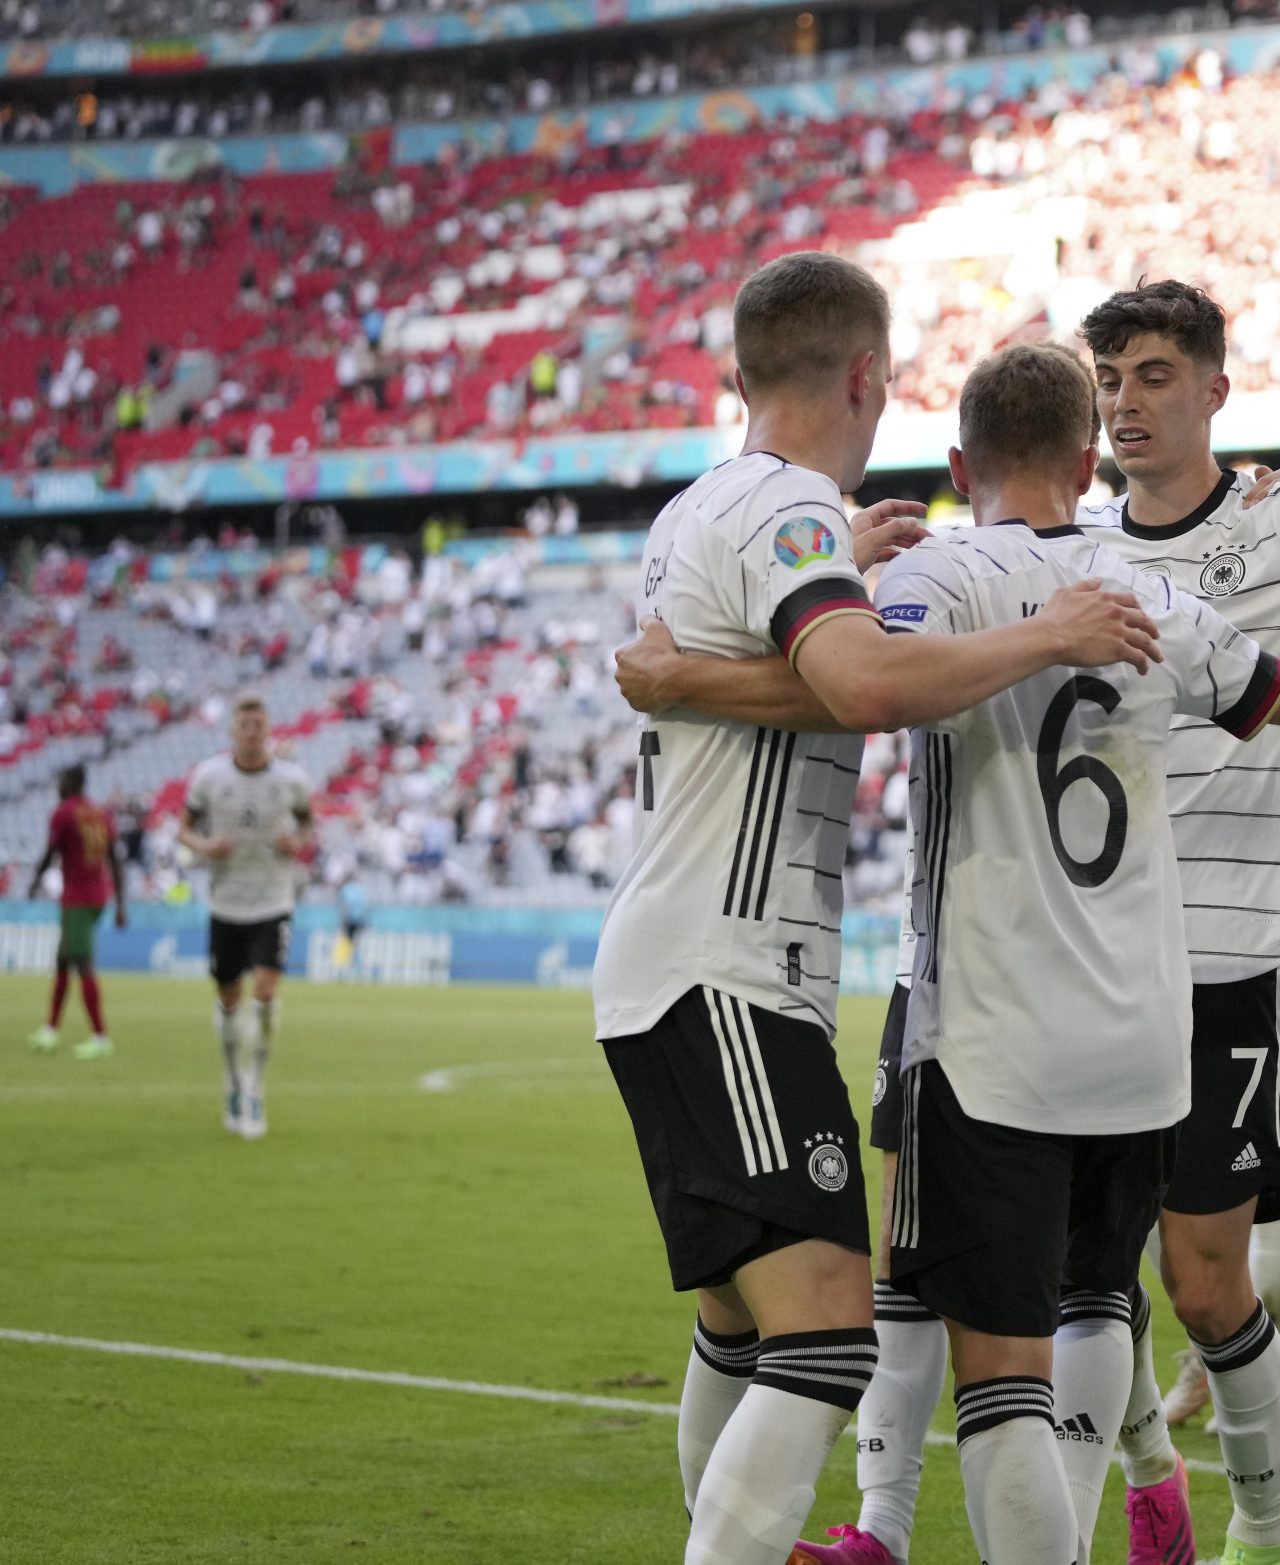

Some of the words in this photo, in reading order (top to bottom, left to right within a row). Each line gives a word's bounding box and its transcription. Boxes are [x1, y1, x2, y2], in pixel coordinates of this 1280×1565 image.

[880, 608, 926, 618] SPECT
[1037, 675, 1128, 888] 6
[1231, 1047, 1269, 1128] 7
[1231, 1158, 1261, 1171] adidas
[1055, 1430, 1104, 1445] didas
[857, 1438, 885, 1453] FB
[1226, 1468, 1275, 1484] DFB
